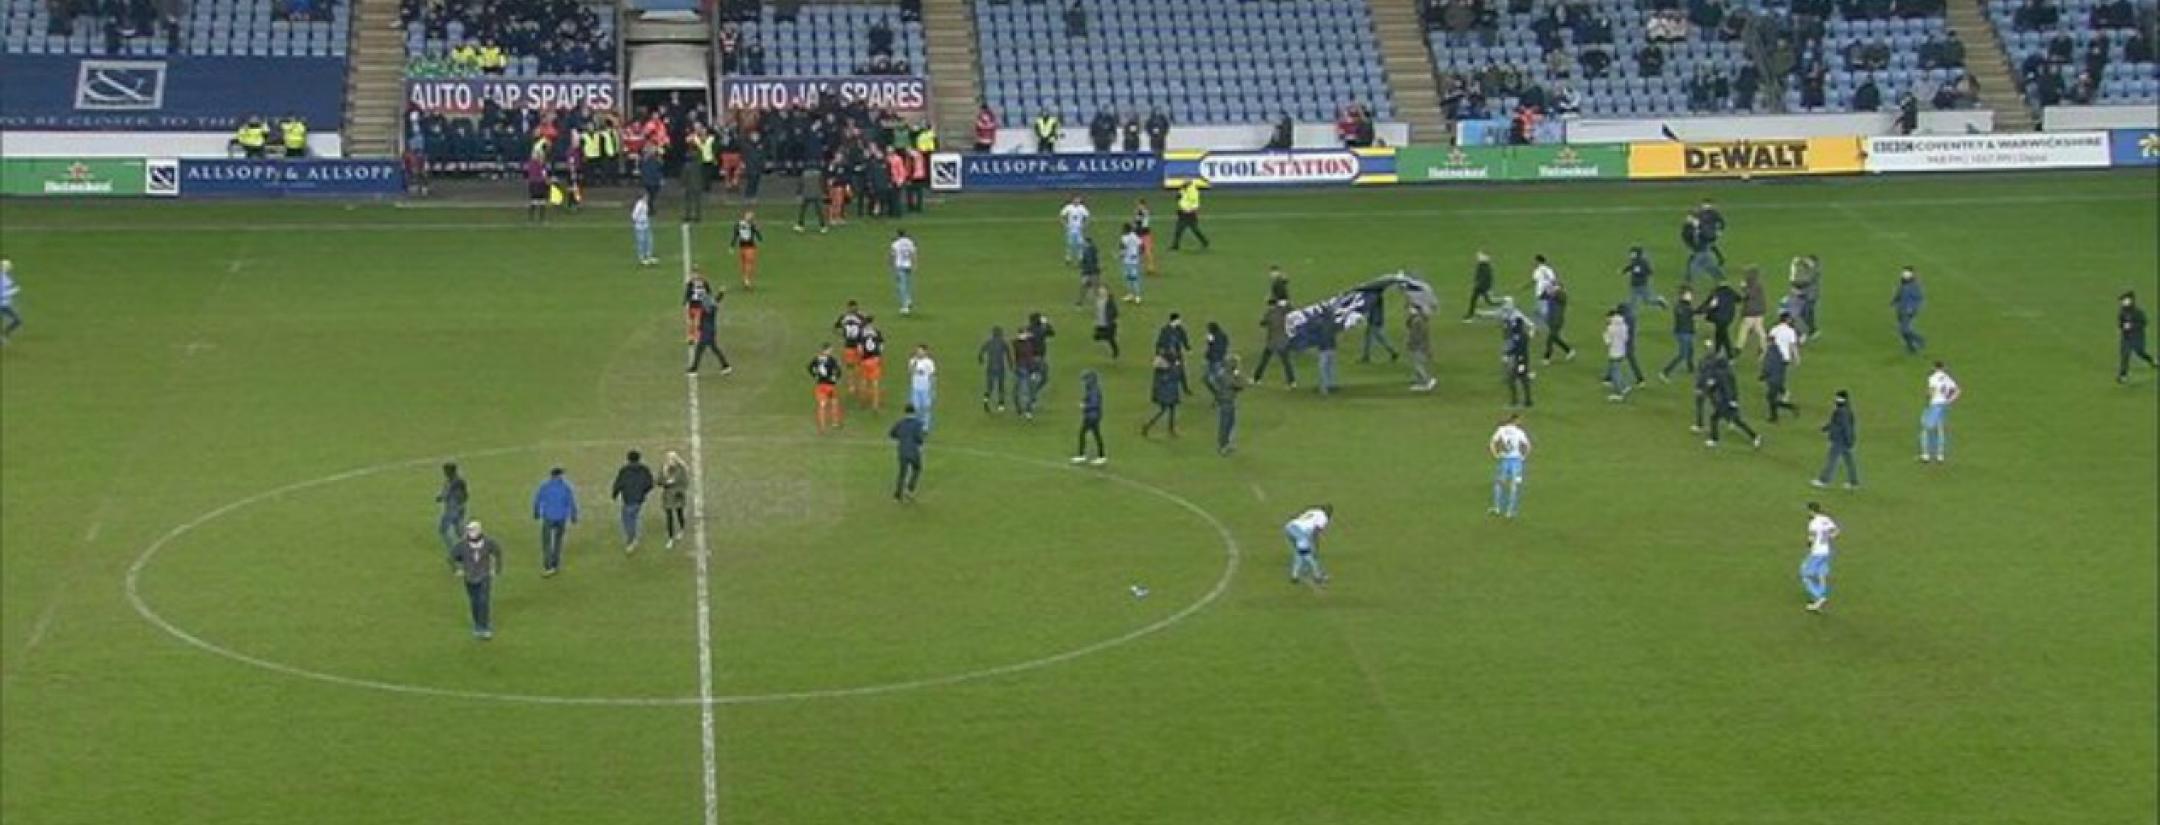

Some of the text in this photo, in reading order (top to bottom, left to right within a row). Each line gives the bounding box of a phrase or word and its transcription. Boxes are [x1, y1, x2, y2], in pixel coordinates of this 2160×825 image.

[410, 83, 471, 110] AUTO
[729, 82, 787, 110] AUTO
[161, 116, 189, 126] TO
[188, 166, 394, 180] ALLSOPP & ALLSOPP
[969, 158, 1156, 174] ALLSOPP & ALLSOPP
[1204, 158, 1354, 177] TOOLSTATION
